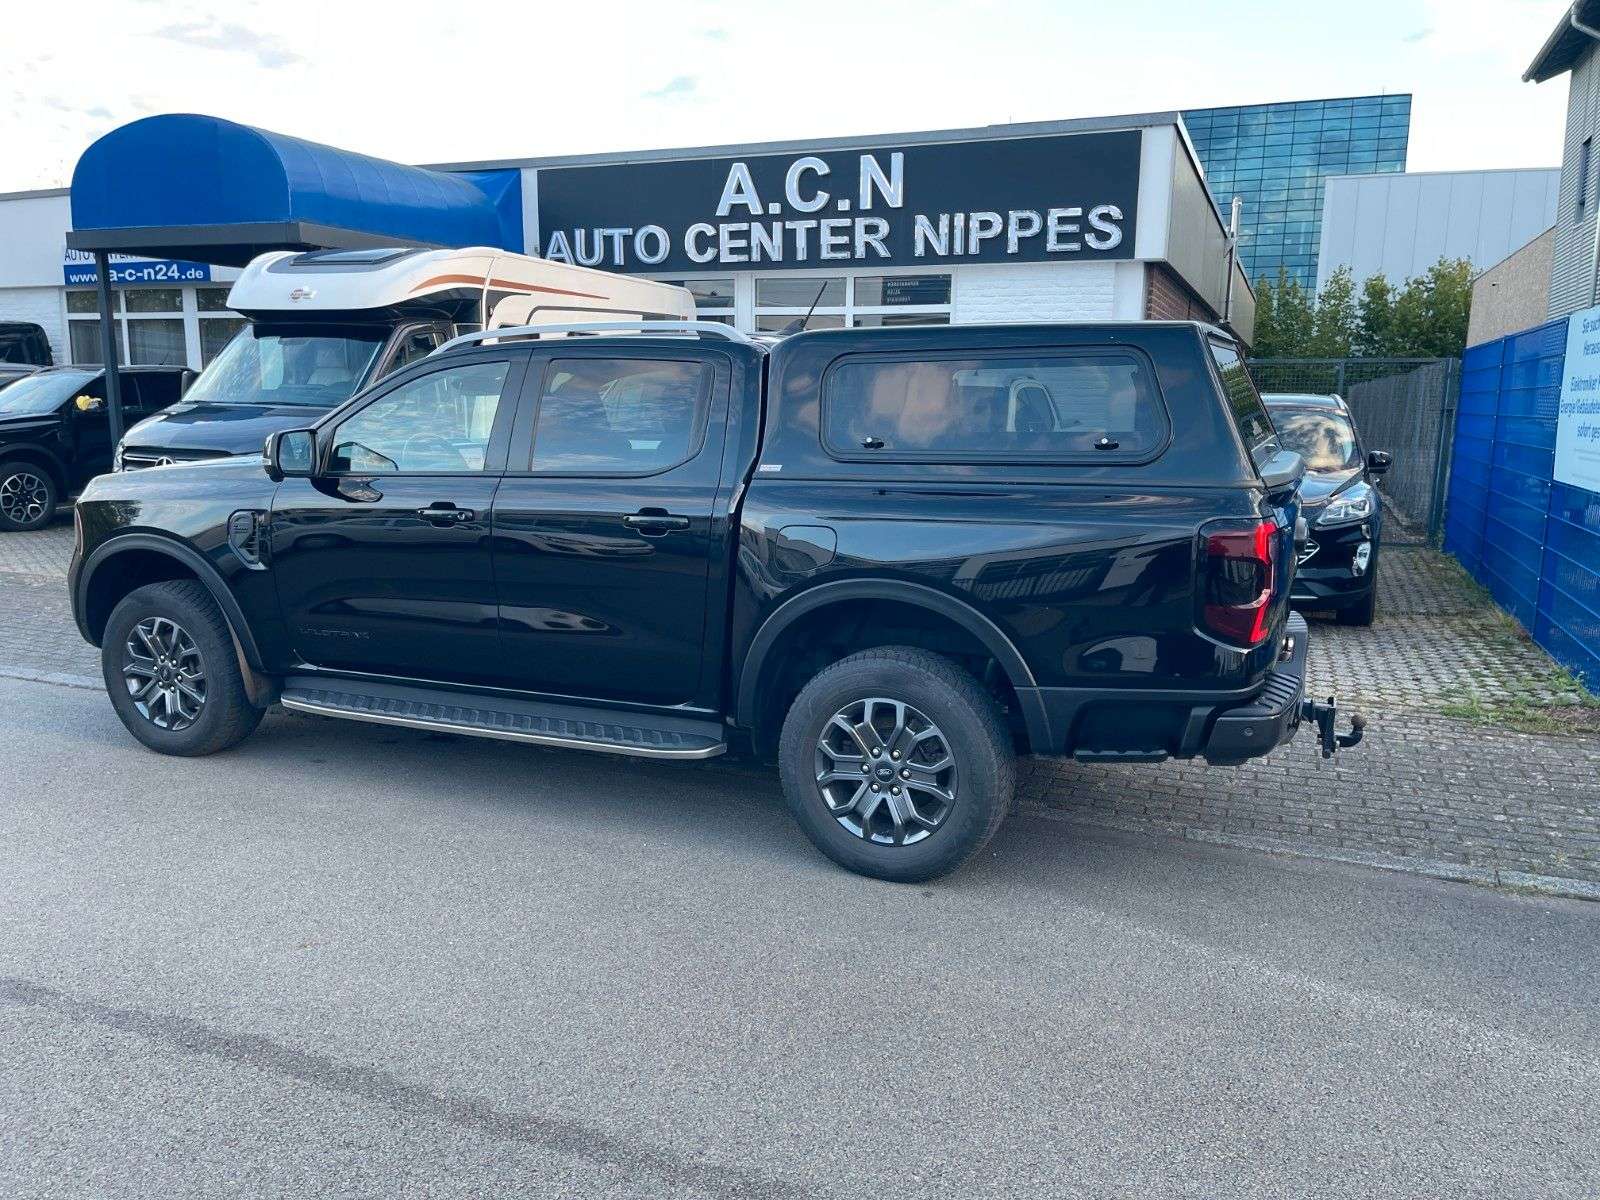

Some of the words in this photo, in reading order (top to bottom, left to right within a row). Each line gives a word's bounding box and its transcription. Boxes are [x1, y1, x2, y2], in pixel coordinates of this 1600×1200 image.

[715, 152, 905, 217] A.C.N
[546, 225, 671, 267] AUTO
[685, 217, 893, 263] CENTER
[914, 204, 1124, 257] NIPPES
[69, 263, 204, 283] wwwa-c-n24.de
